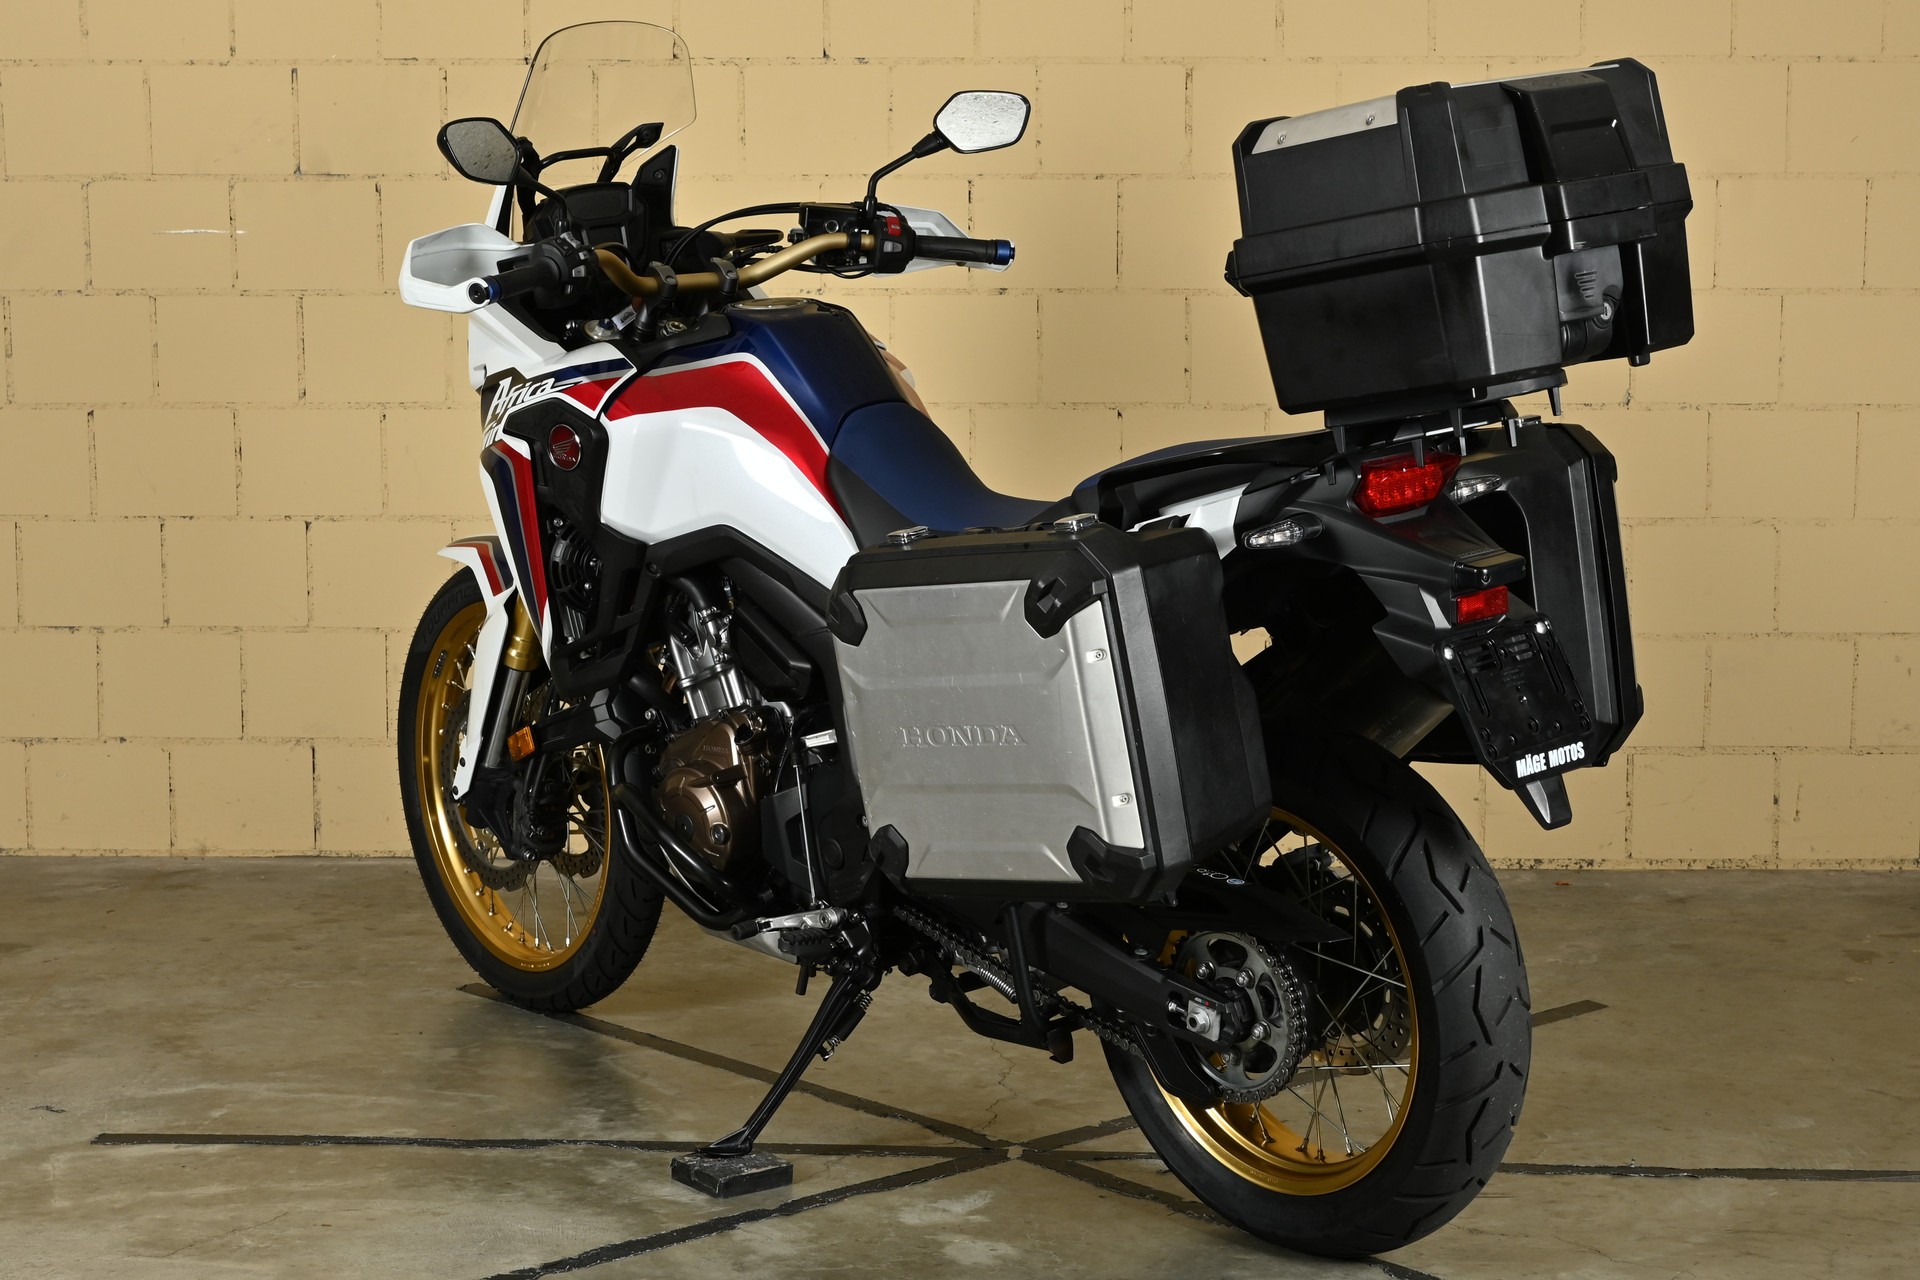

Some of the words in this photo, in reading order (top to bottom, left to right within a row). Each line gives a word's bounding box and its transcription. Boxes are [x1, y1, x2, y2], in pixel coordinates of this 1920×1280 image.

[484, 376, 574, 428] Africa
[702, 744, 729, 754] HONDA
[899, 725, 1028, 749] HONDA
[1515, 752, 1547, 778] MÄGE
[1548, 741, 1585, 768] MOTOS
